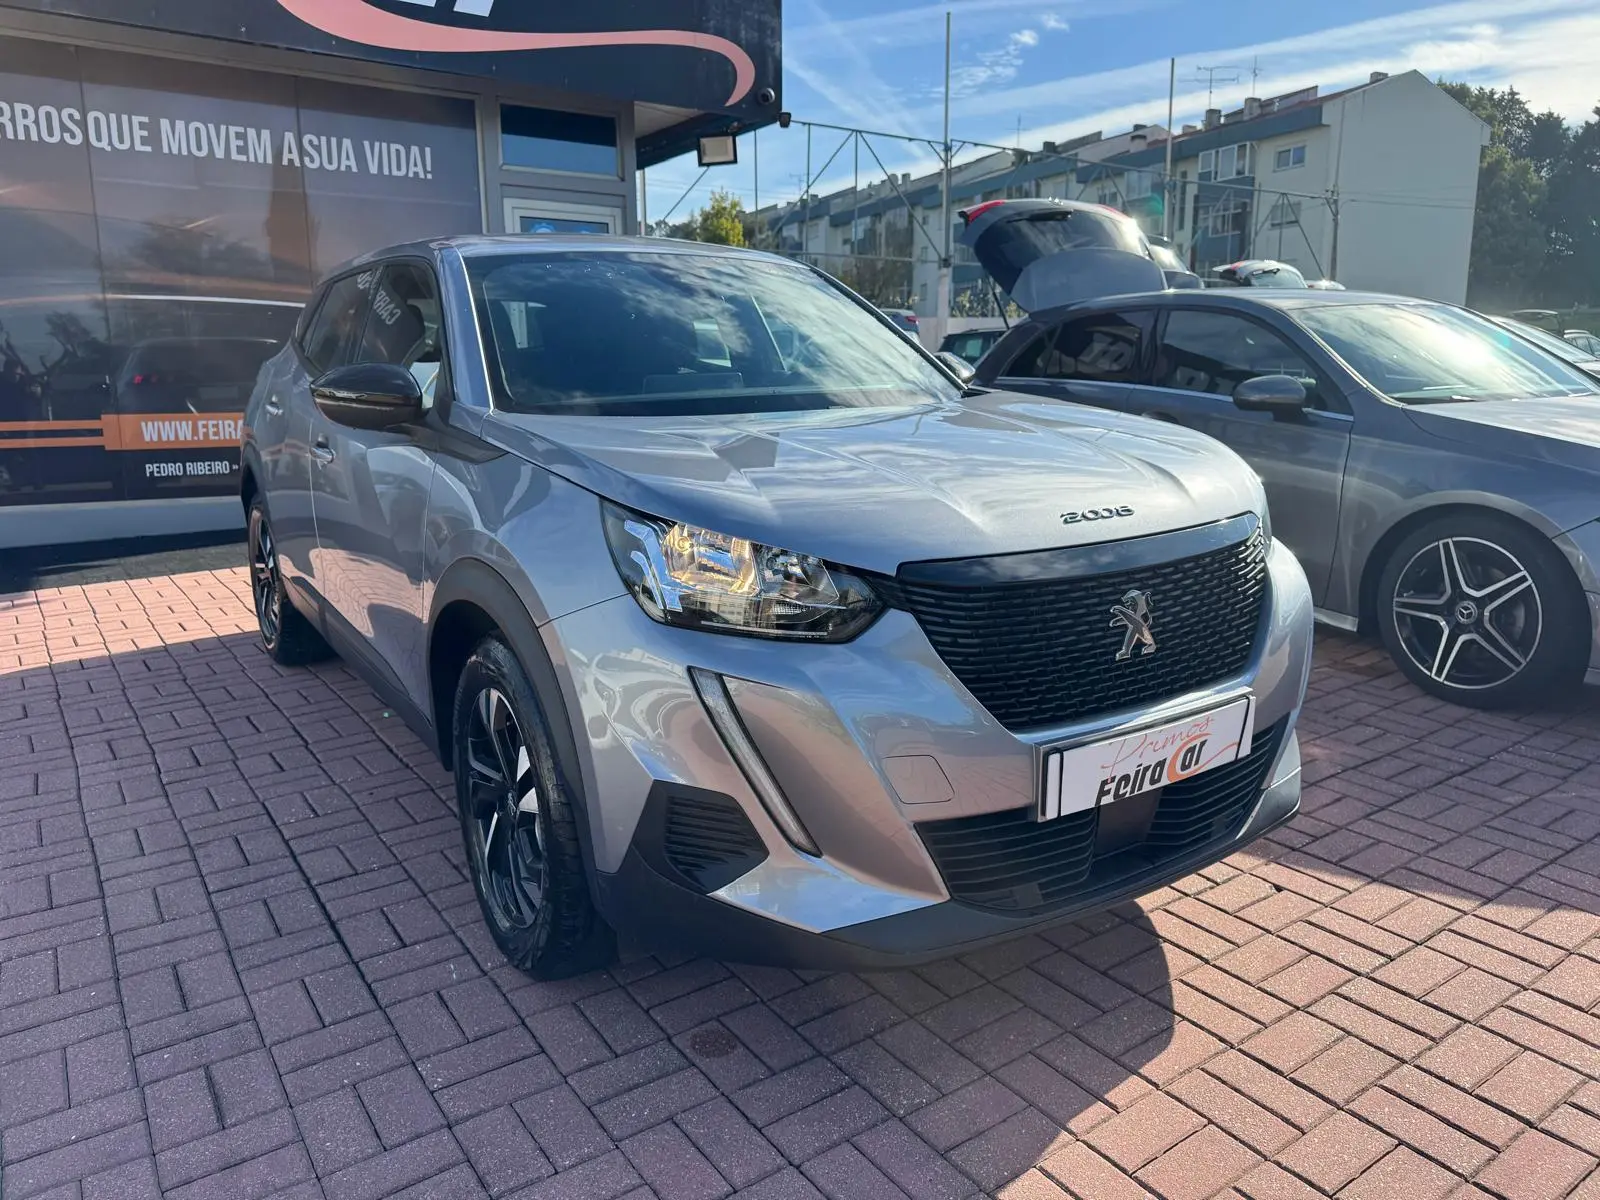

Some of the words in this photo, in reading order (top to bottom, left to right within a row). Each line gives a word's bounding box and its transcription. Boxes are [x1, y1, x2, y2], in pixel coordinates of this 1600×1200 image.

[87, 109, 152, 152] QUE
[160, 118, 273, 165] MOVEM
[282, 132, 301, 167] A
[301, 134, 358, 172] SUA
[364, 140, 433, 180] VIDA!
[145, 462, 184, 477] PEDRO
[186, 460, 230, 476] RIBEIRO
[1060, 505, 1135, 525] 2008
